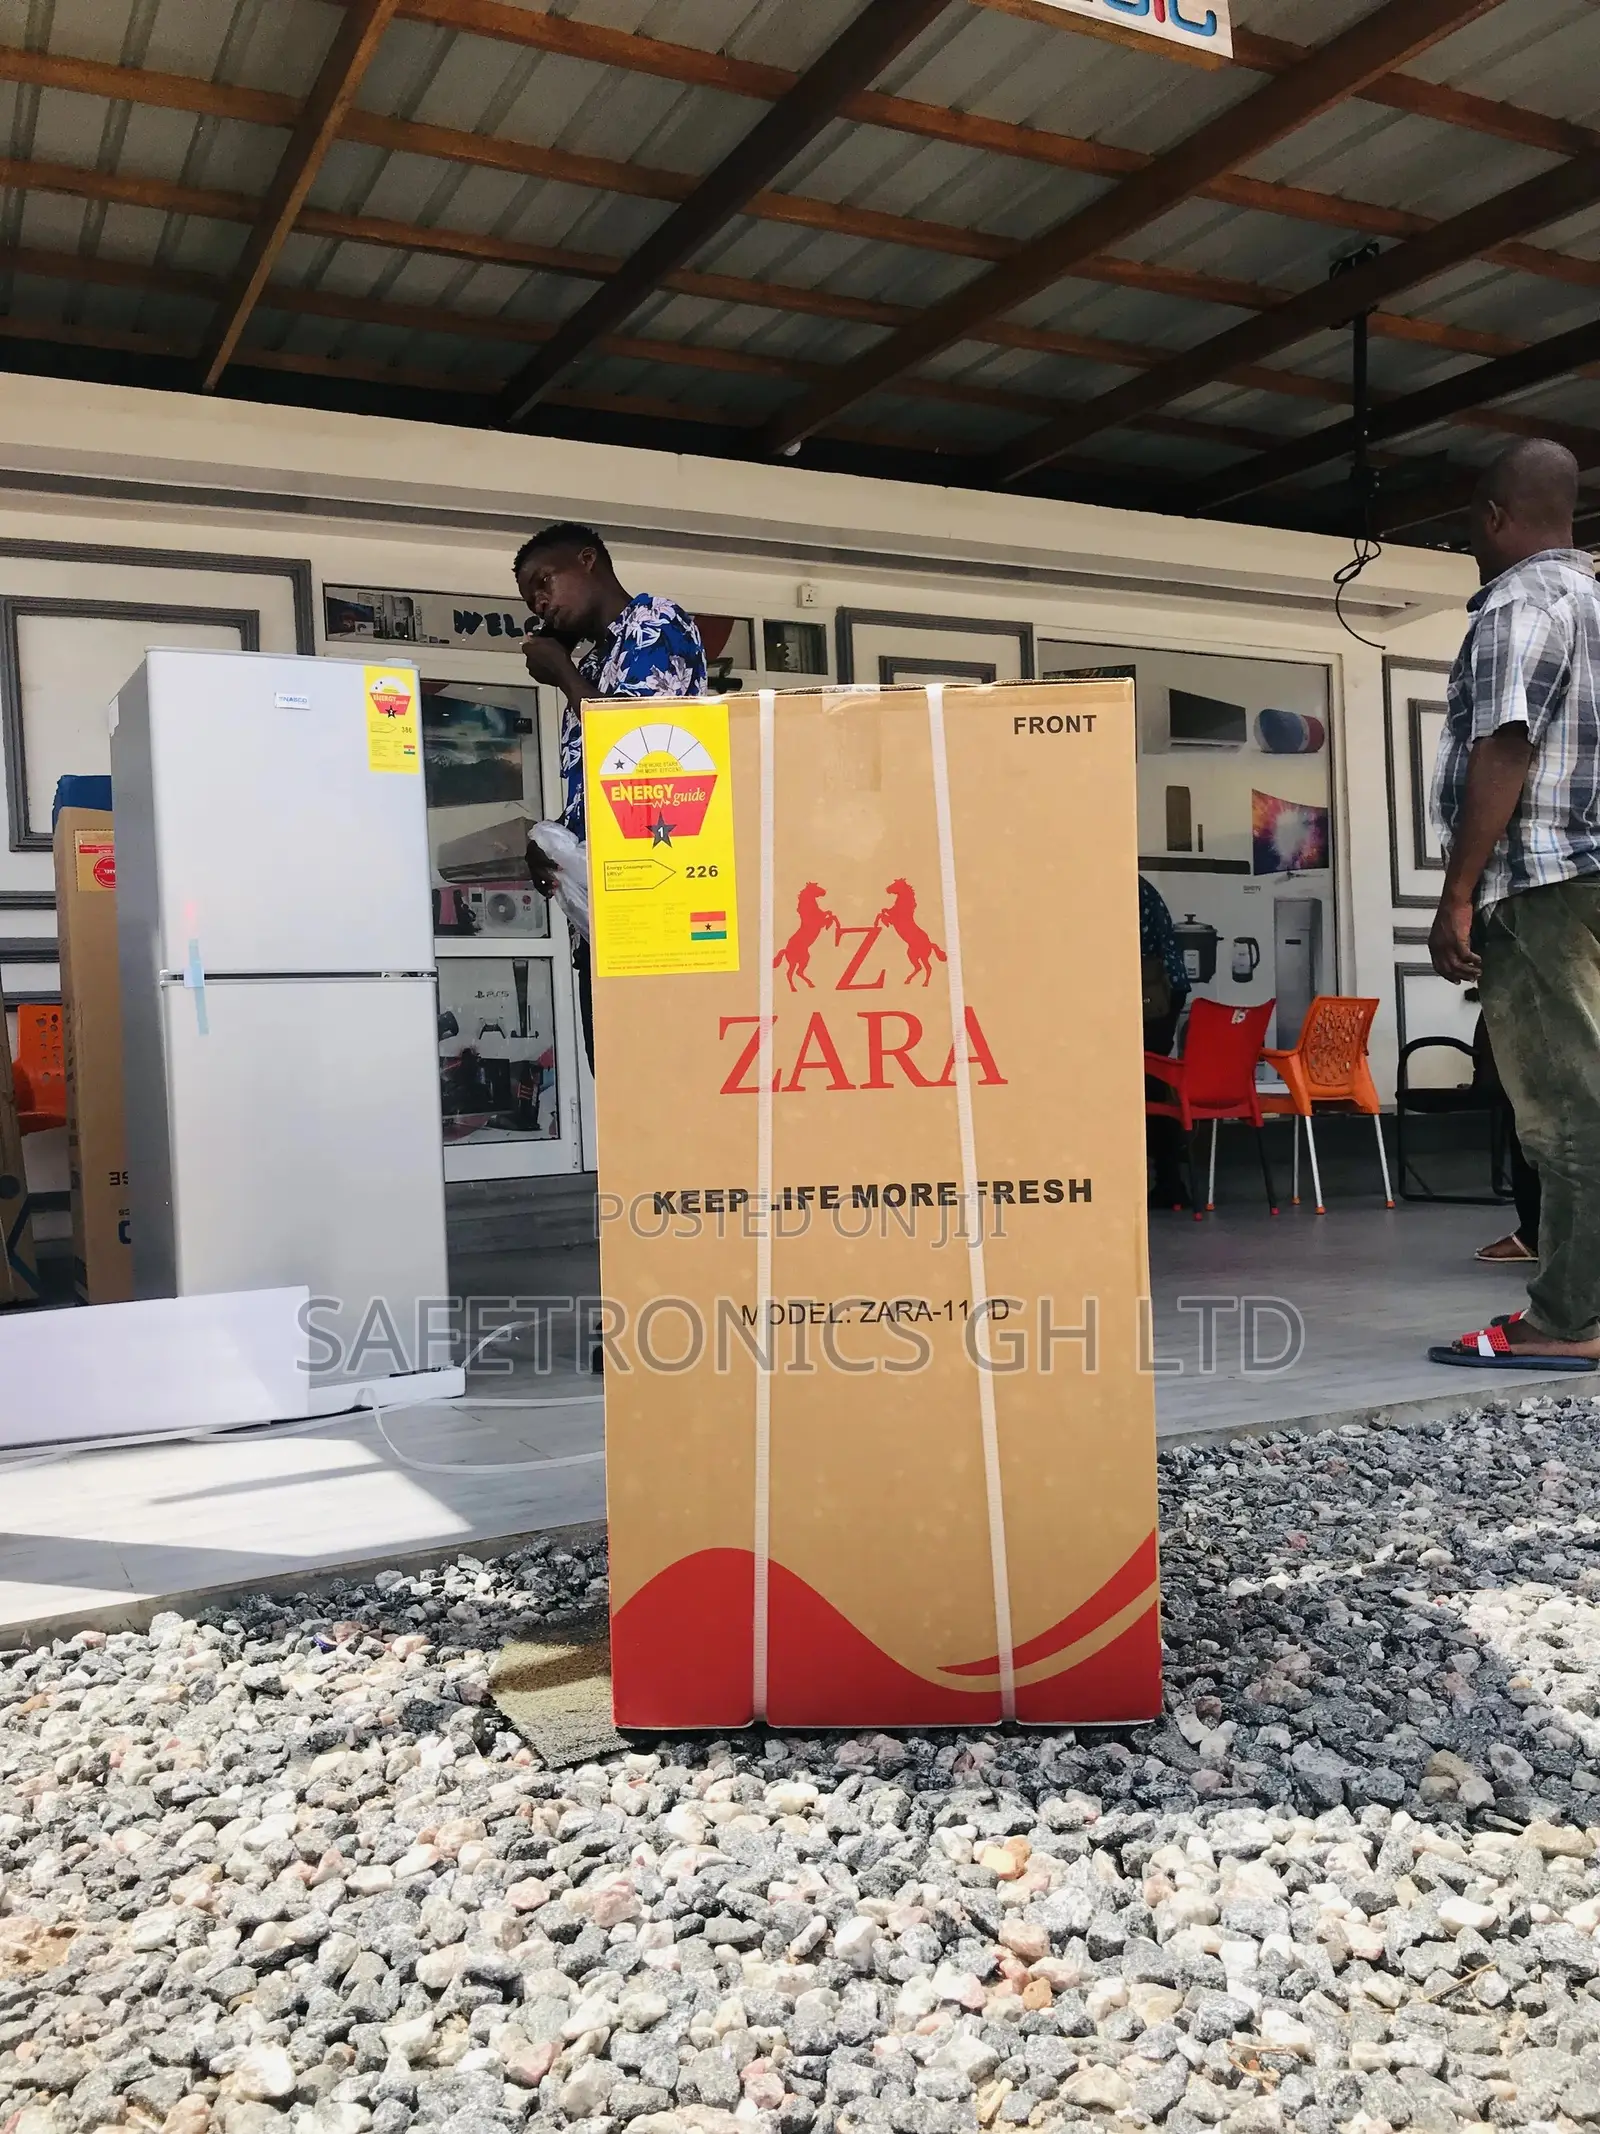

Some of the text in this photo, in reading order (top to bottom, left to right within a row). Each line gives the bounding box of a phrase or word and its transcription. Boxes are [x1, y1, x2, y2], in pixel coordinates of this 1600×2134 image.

[453, 609, 541, 638] WELC
[1013, 714, 1097, 735] FRONT
[611, 781, 707, 807] ENERGY guide
[658, 826, 664, 838] 1
[685, 865, 719, 879] 226
[834, 926, 886, 990] Z
[719, 1005, 1008, 1094] ZARA
[654, 1188, 749, 1215] KEEP
[852, 1181, 958, 1208] MORE
[741, 1299, 1010, 1326] MODEL: ZARA-11D
